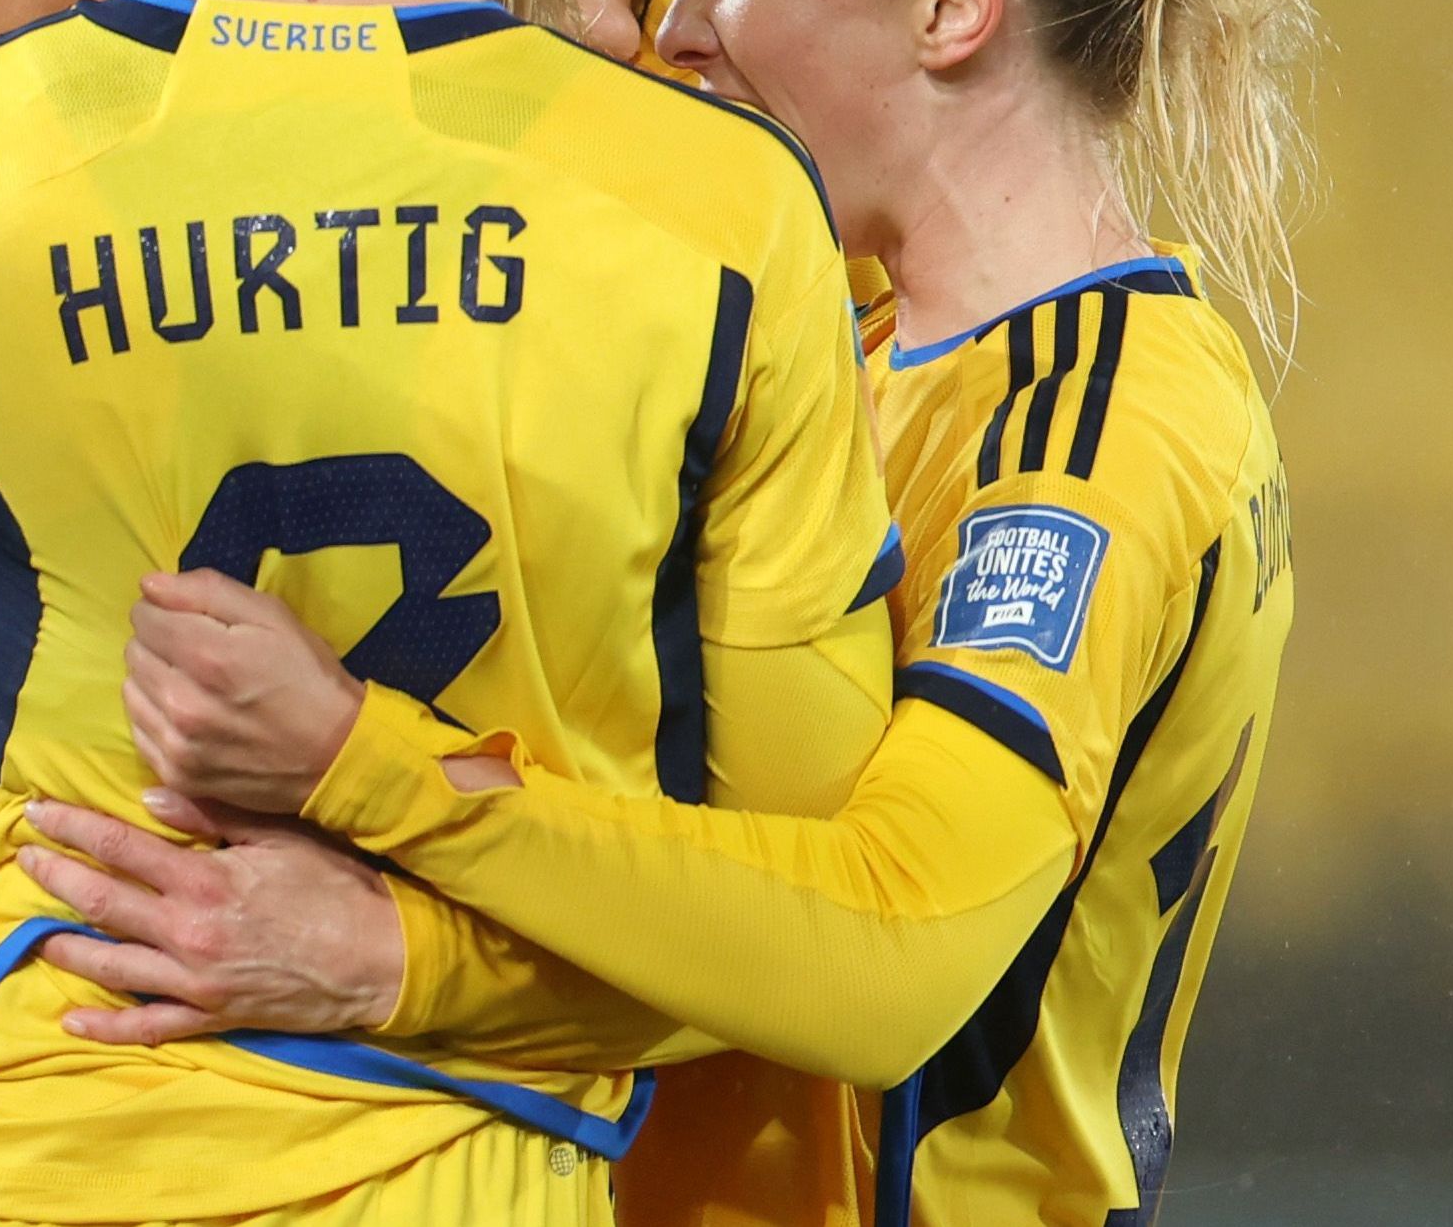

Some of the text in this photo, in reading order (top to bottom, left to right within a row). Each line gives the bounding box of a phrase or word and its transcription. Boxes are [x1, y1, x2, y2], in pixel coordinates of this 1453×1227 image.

[211, 15, 377, 52] SVERIGE
[49, 205, 528, 365] HURTIG
[987, 527, 1070, 557] FOOTBALL
[976, 547, 1068, 583] UNITES
[966, 575, 1066, 612] the World
[992, 606, 1024, 621] FIFA
